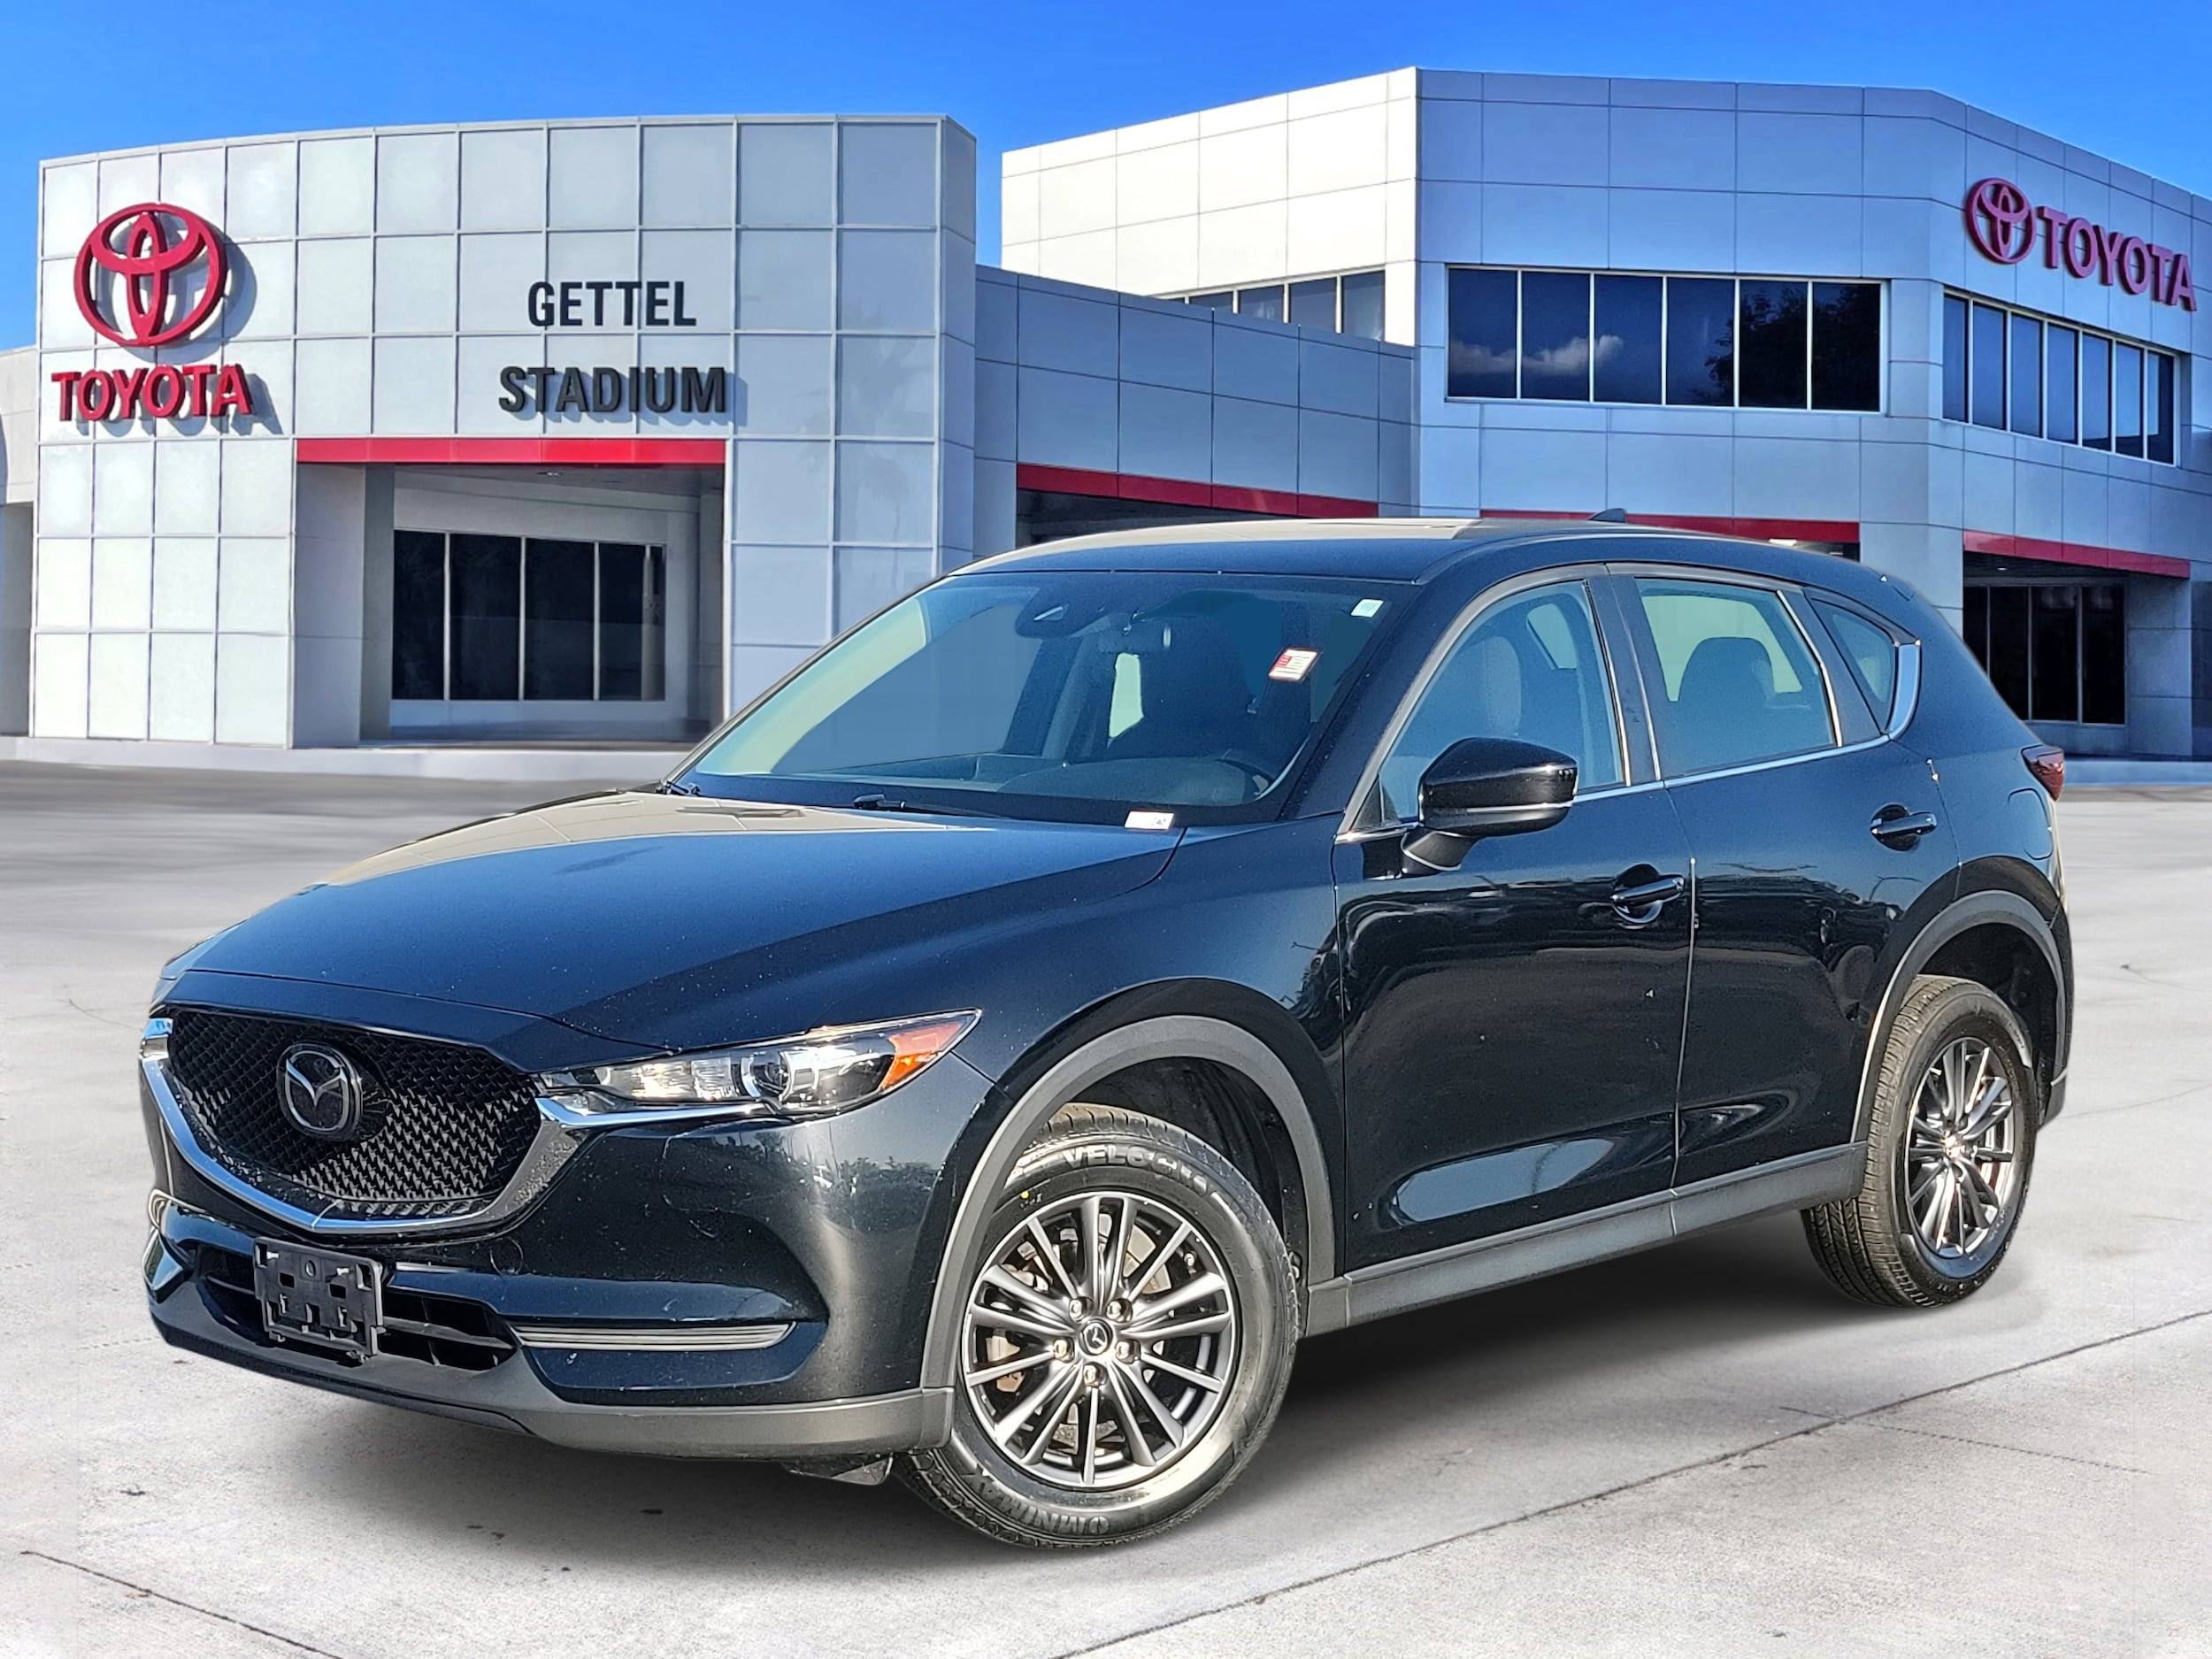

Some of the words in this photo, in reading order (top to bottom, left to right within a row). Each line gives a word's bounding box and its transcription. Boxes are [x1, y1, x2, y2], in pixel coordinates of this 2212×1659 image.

[2036, 206, 2197, 311] TOYOTA
[528, 281, 696, 326] GETTEL
[51, 364, 255, 421] TOYOTA
[498, 366, 726, 413] STADIUM
